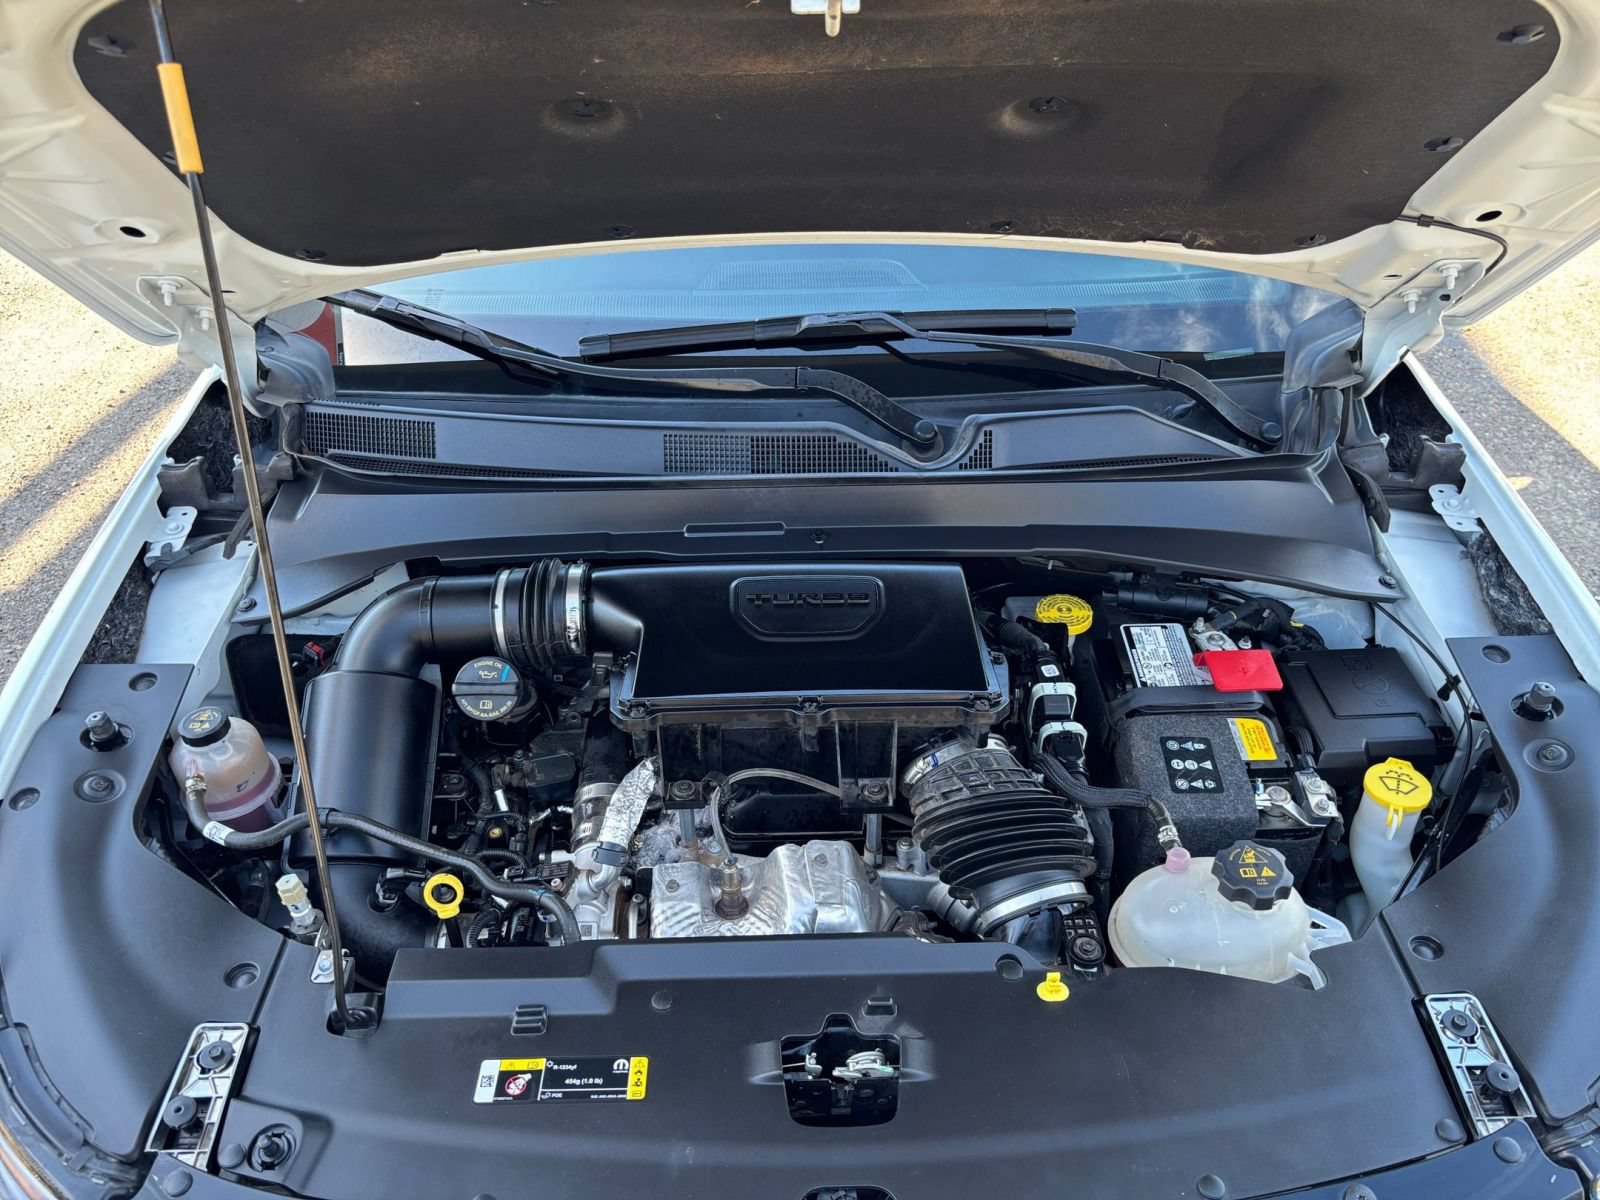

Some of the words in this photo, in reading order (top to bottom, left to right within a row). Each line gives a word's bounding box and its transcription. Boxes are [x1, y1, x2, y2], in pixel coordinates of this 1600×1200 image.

[746, 592, 870, 605] TURBO
[564, 1078, 581, 1086] 454g
[594, 1077, 604, 1085] lb)
